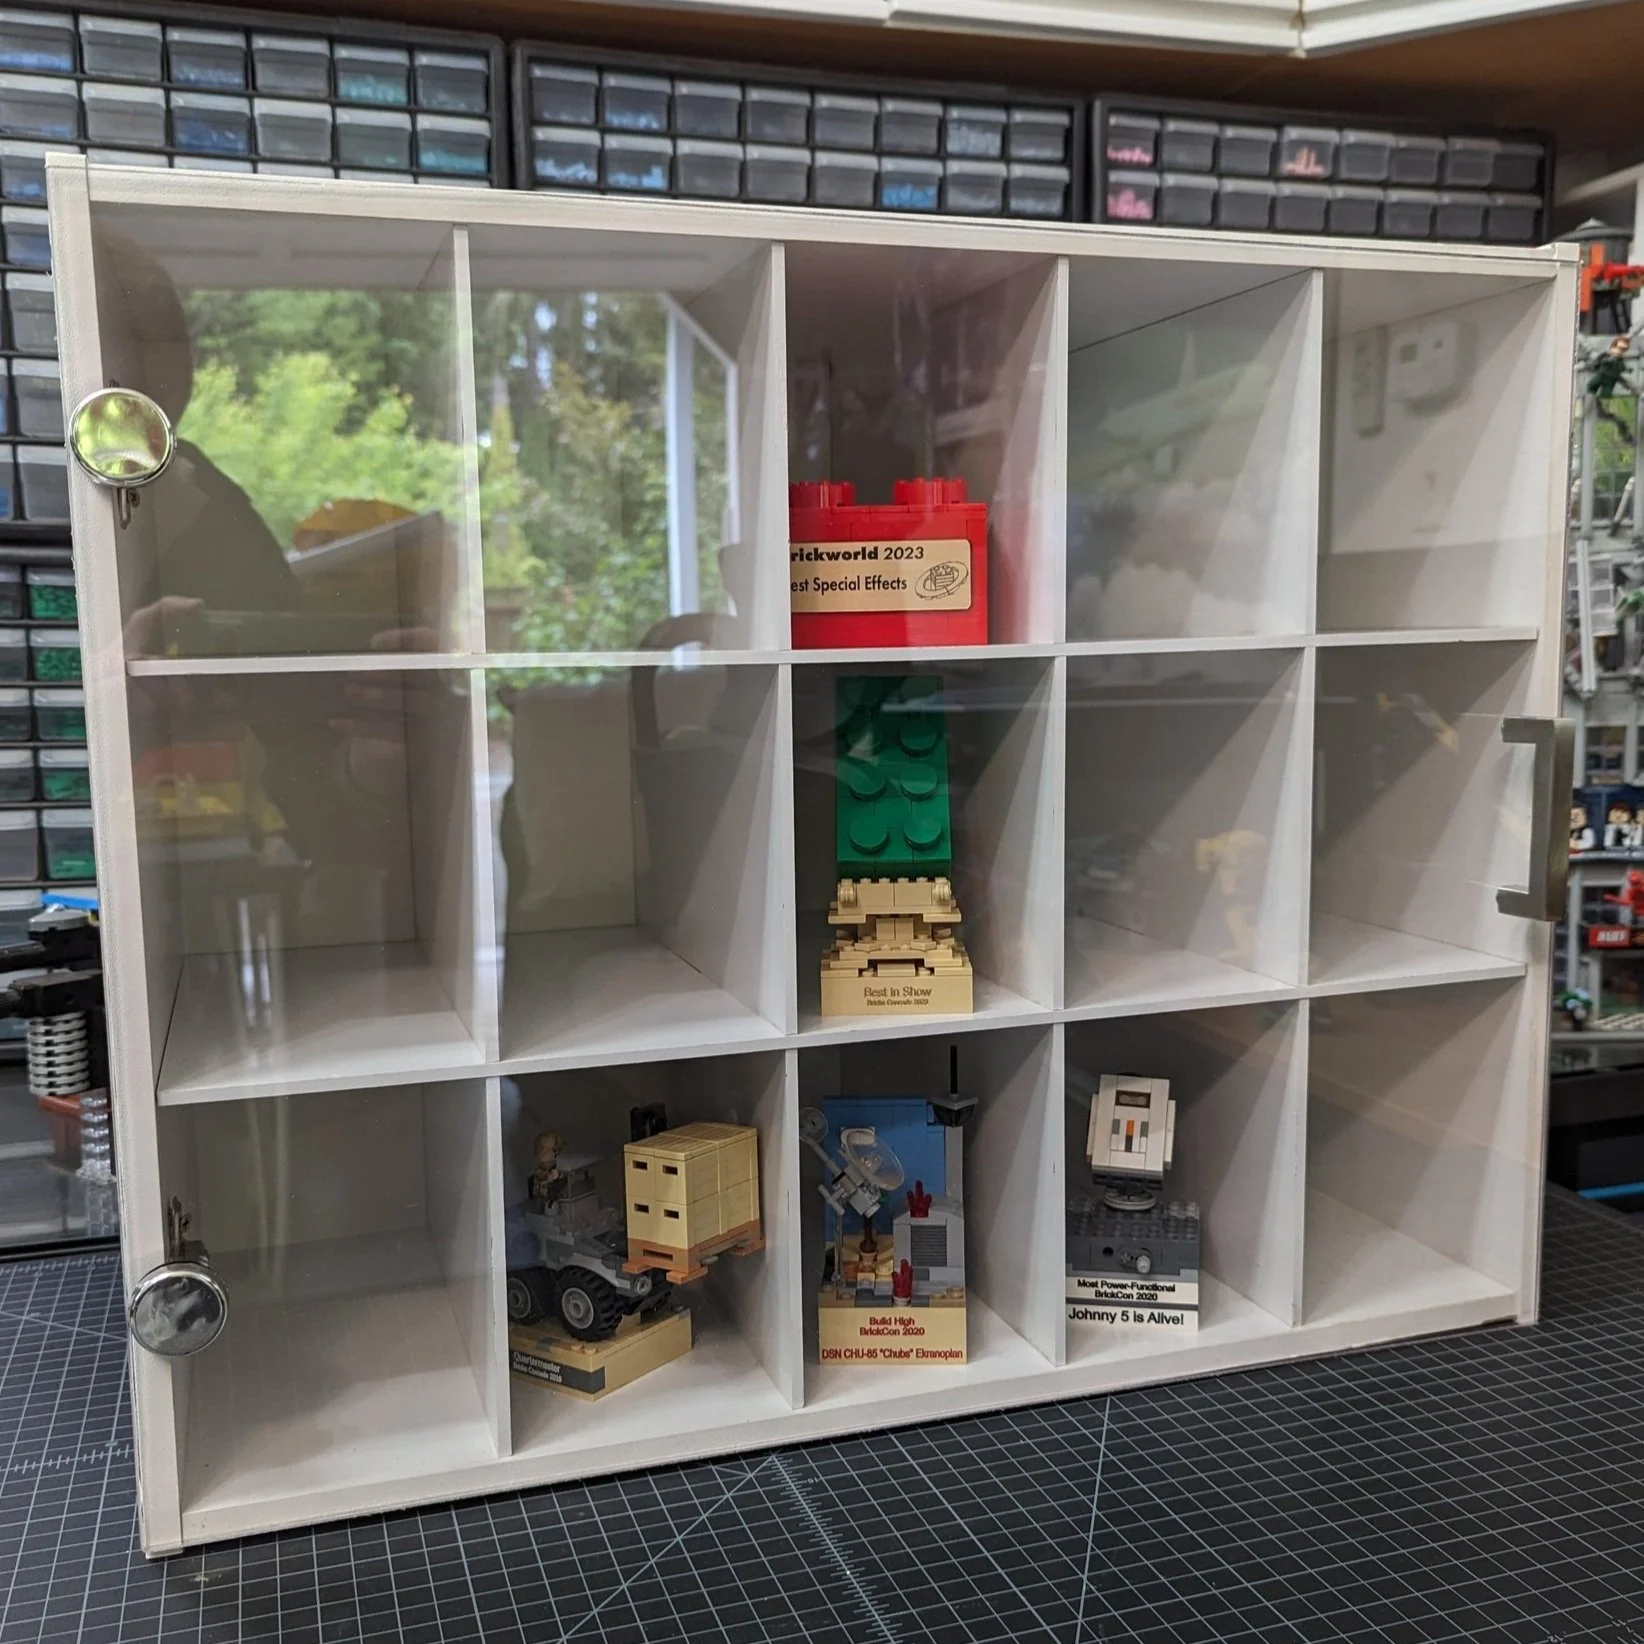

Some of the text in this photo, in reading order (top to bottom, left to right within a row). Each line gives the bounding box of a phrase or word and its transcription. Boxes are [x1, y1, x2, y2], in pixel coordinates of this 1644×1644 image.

[791, 546, 924, 562] rickworld 2023
[791, 575, 907, 595] est Special Effects
[864, 987, 888, 997] Best
[903, 986, 932, 997] Show
[1077, 1279, 1176, 1292] Most Power-Functional
[1094, 1290, 1158, 1301] BrickCon 2020
[1068, 1307, 1117, 1324] Johnny
[1120, 1310, 1129, 1322] 5
[1147, 1311, 1184, 1325] Alive!
[869, 1317, 915, 1328] Build High
[859, 1327, 925, 1336] BrickCon 2020
[822, 1349, 842, 1359] DSN
[844, 1348, 877, 1359] CHU-85
[916, 1348, 963, 1360] Ekranoplan
